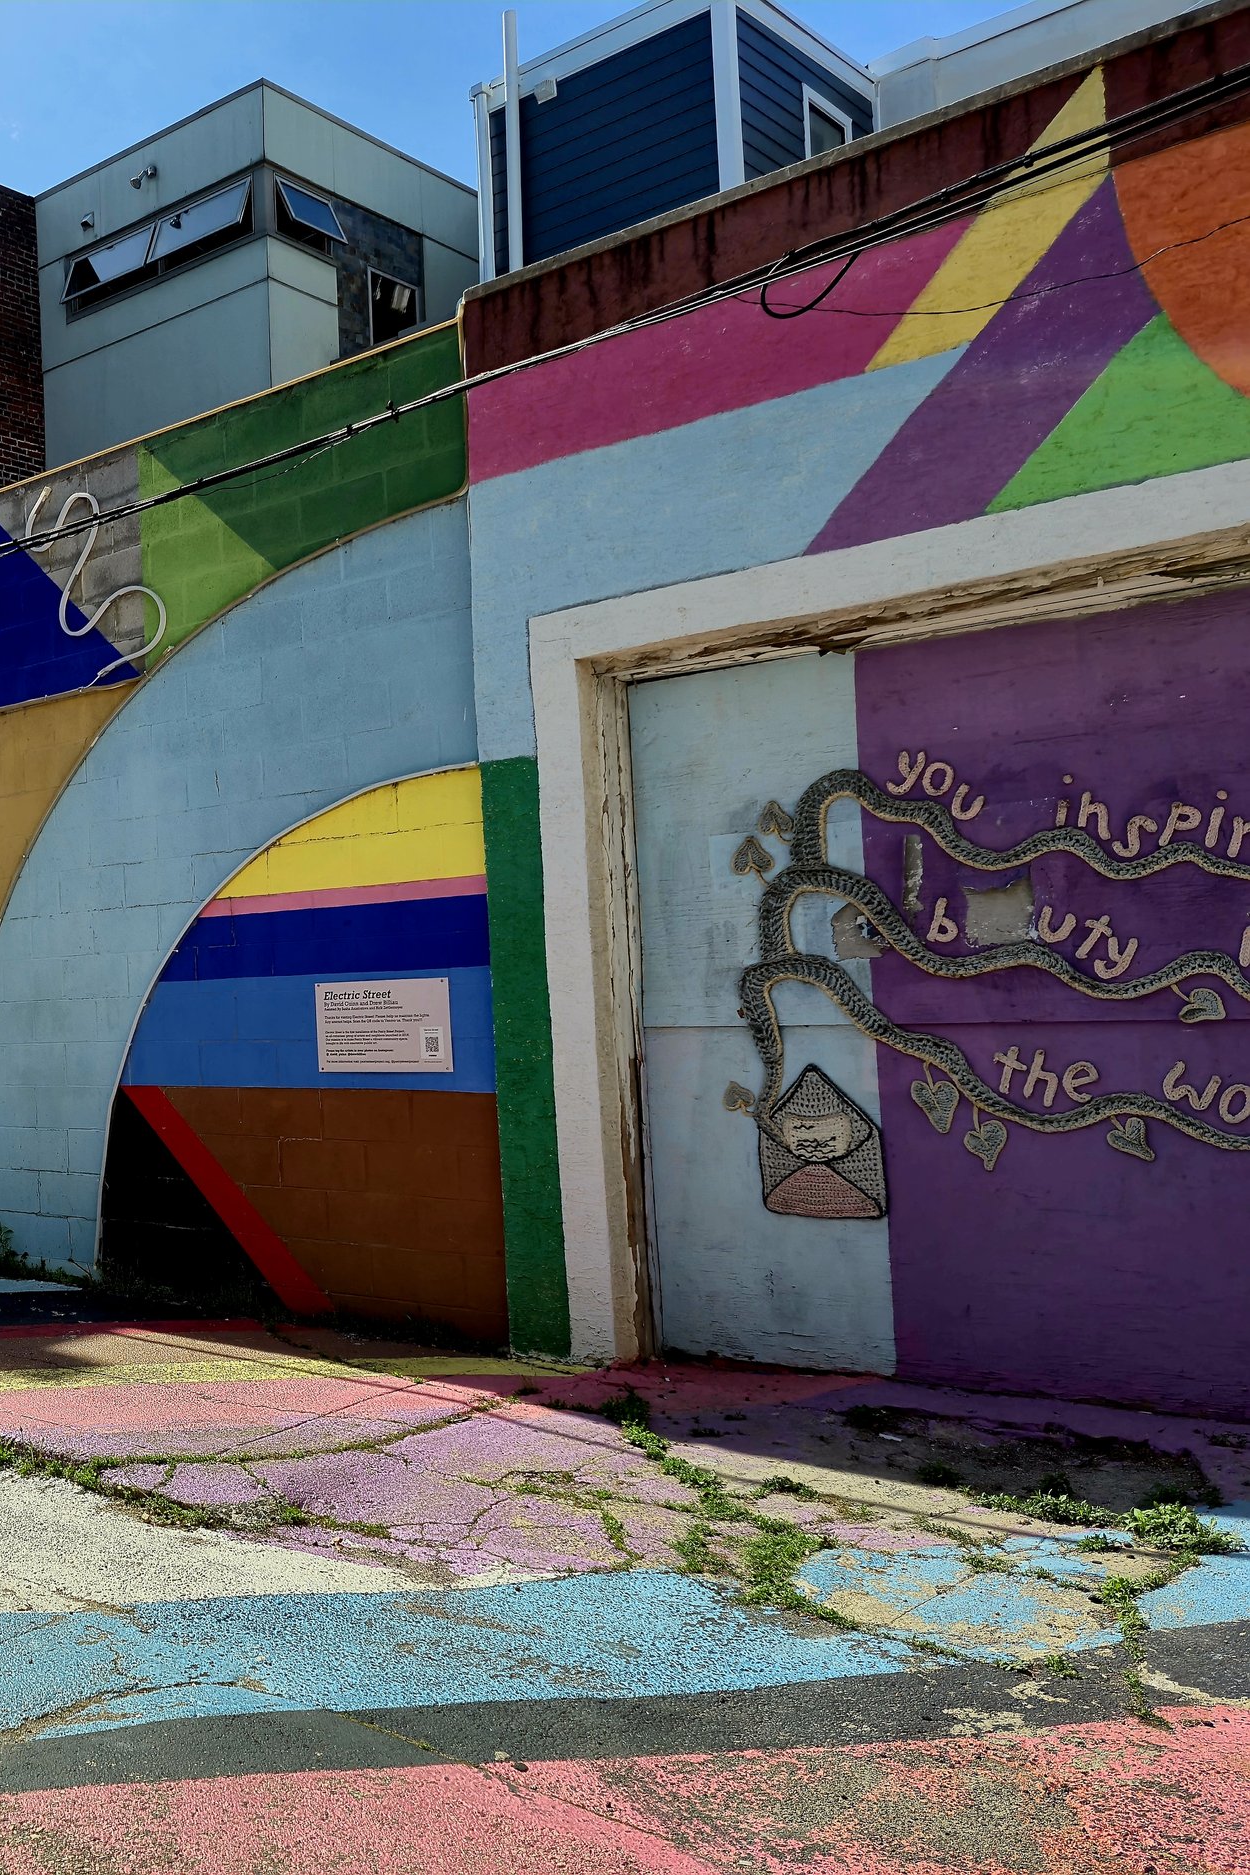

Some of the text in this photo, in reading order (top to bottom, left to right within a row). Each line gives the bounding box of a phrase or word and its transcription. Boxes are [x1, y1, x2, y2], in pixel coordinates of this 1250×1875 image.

[886, 750, 1250, 858] you inspir
[324, 989, 392, 1001] Electric Street
[993, 1046, 1250, 1124] the wo
